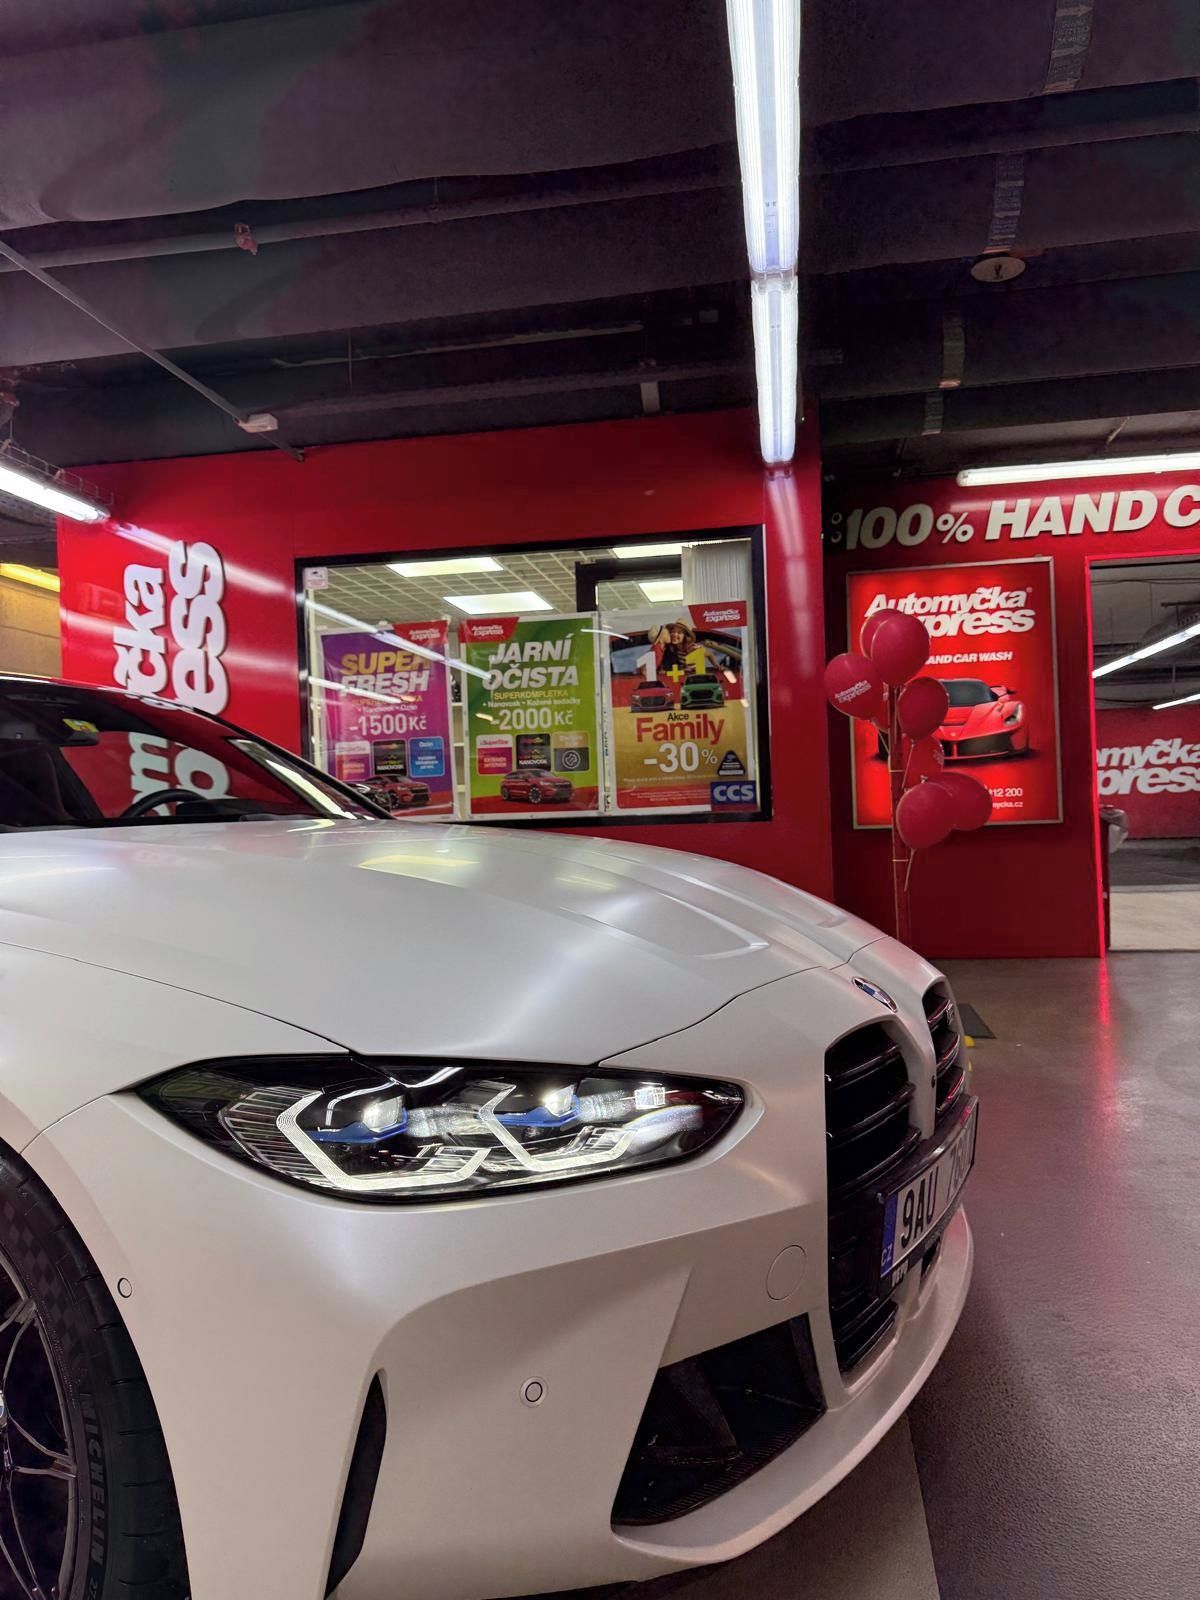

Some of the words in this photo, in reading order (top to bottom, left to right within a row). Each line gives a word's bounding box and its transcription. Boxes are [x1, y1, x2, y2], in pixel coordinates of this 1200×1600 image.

[985, 490, 1158, 541] HAND
[864, 586, 1027, 618] Automyčka
[489, 633, 574, 664] JARNÍ
[925, 654, 952, 665] AND
[953, 653, 978, 664] CAR
[979, 651, 1013, 662] WASH
[340, 650, 432, 675] SUPER
[340, 670, 430, 696] FRESH
[482, 664, 579, 690] OČISTA
[349, 714, 407, 736] -1500
[409, 715, 427, 730] Kč
[491, 708, 552, 730] -2000
[554, 710, 573, 725] Kč
[636, 714, 725, 745] Family
[667, 713, 689, 722] Akce
[713, 785, 754, 801] CCS
[1005, 787, 1023, 797] 200
[881, 1243, 893, 1267] CZ
[79, 1392, 106, 1568] MICHELIN
